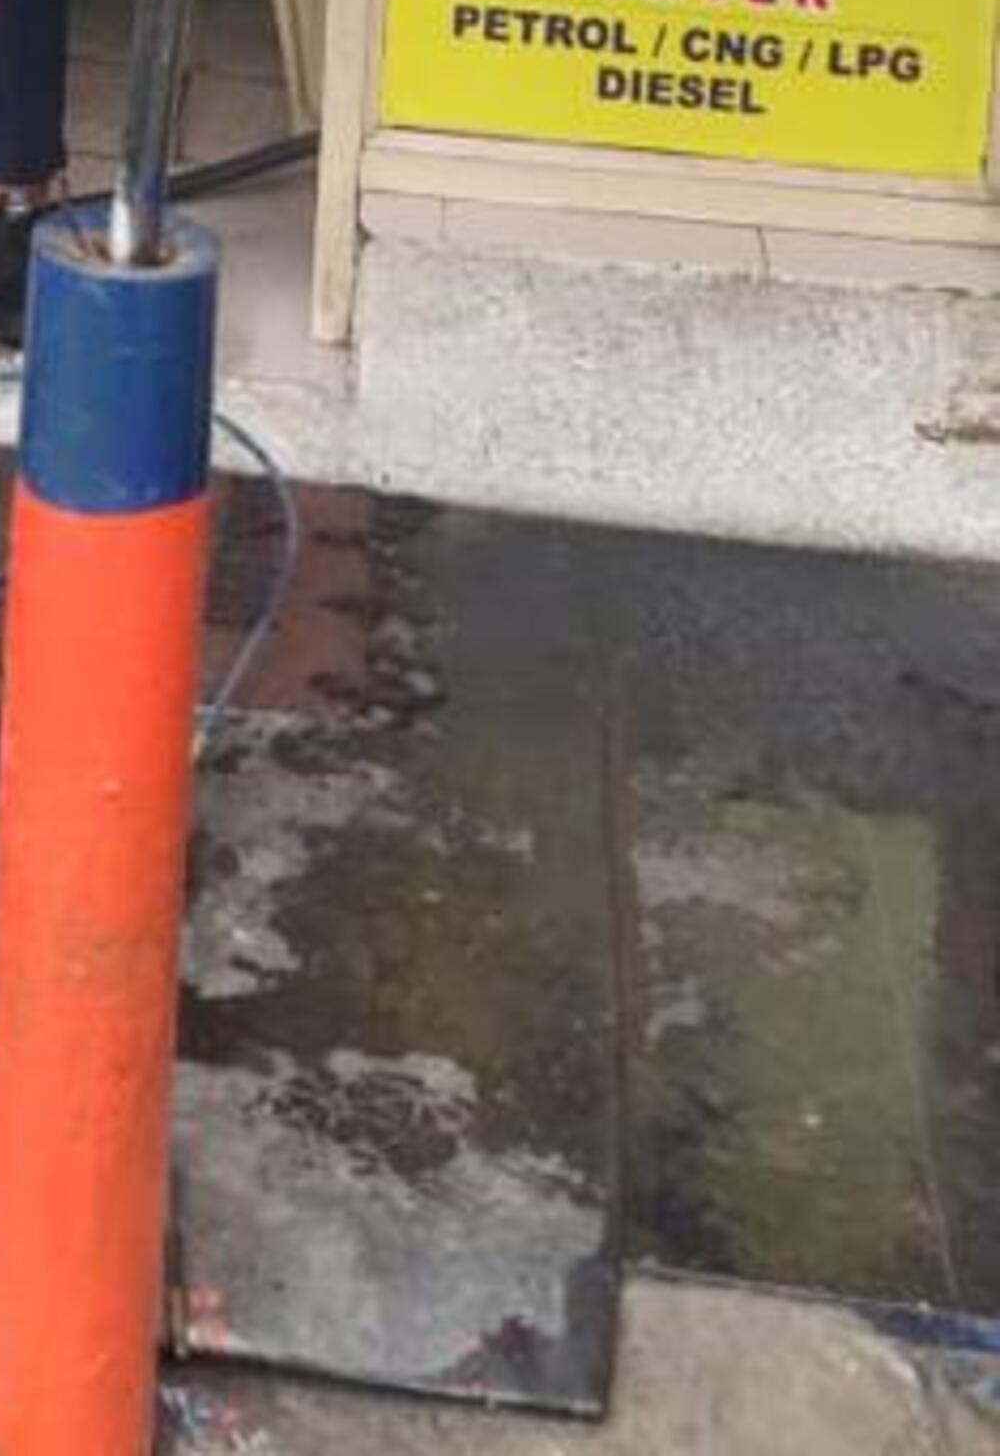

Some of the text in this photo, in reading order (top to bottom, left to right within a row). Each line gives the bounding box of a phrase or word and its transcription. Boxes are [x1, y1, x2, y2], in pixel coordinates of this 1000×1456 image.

[453, 4, 637, 54] PETROL
[680, 28, 783, 68] CNG
[827, 42, 923, 83] LPG
[597, 66, 765, 115] DIESEL
